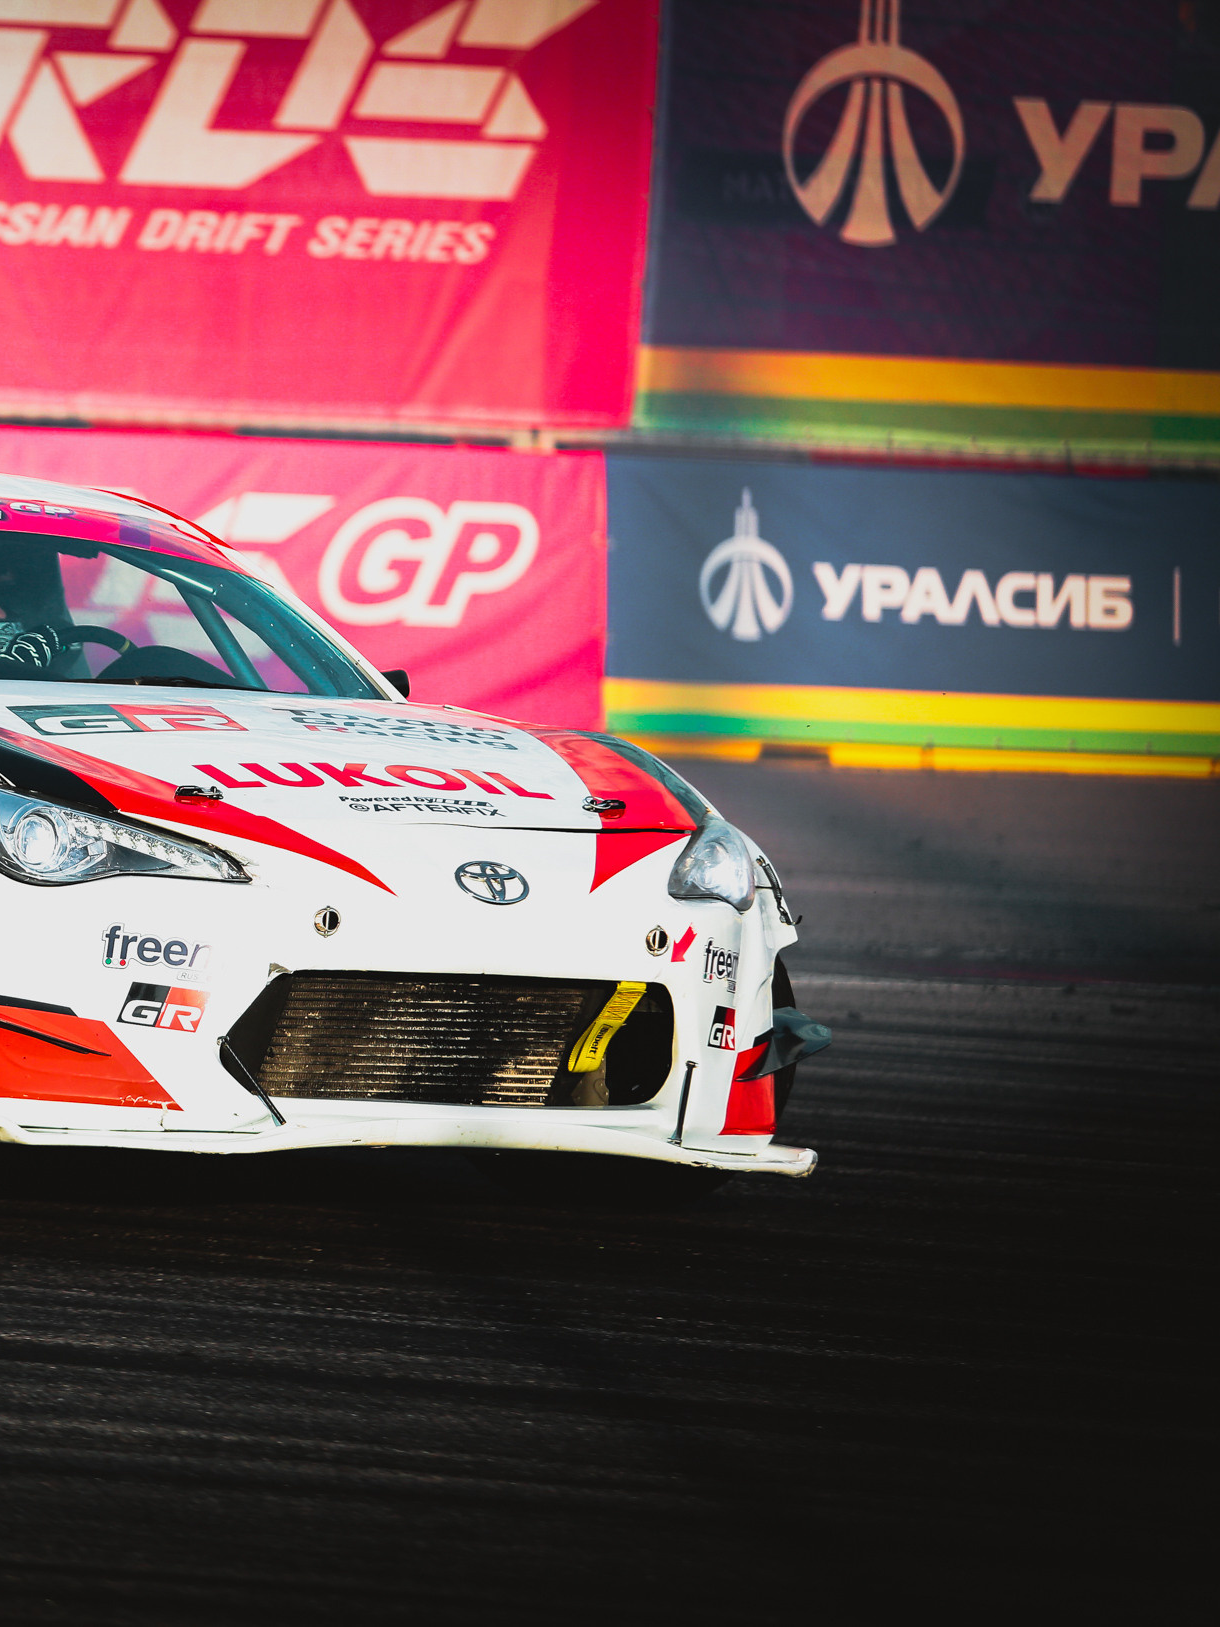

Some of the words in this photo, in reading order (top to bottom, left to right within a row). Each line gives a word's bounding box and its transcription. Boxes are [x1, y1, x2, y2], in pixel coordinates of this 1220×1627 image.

[137, 208, 301, 255] DRIFT
[307, 215, 496, 265] SERIES
[8, 501, 73, 516] GP
[318, 496, 540, 628] GP
[813, 562, 1133, 631] УРАЛСИБ
[32, 710, 238, 735] GR
[271, 708, 511, 734] TOYOTA
[291, 717, 505, 740] GAZOO
[303, 724, 518, 750] Racing
[192, 762, 555, 800] LUKOIL
[121, 1000, 202, 1031] GR
[709, 1022, 735, 1049] GR
